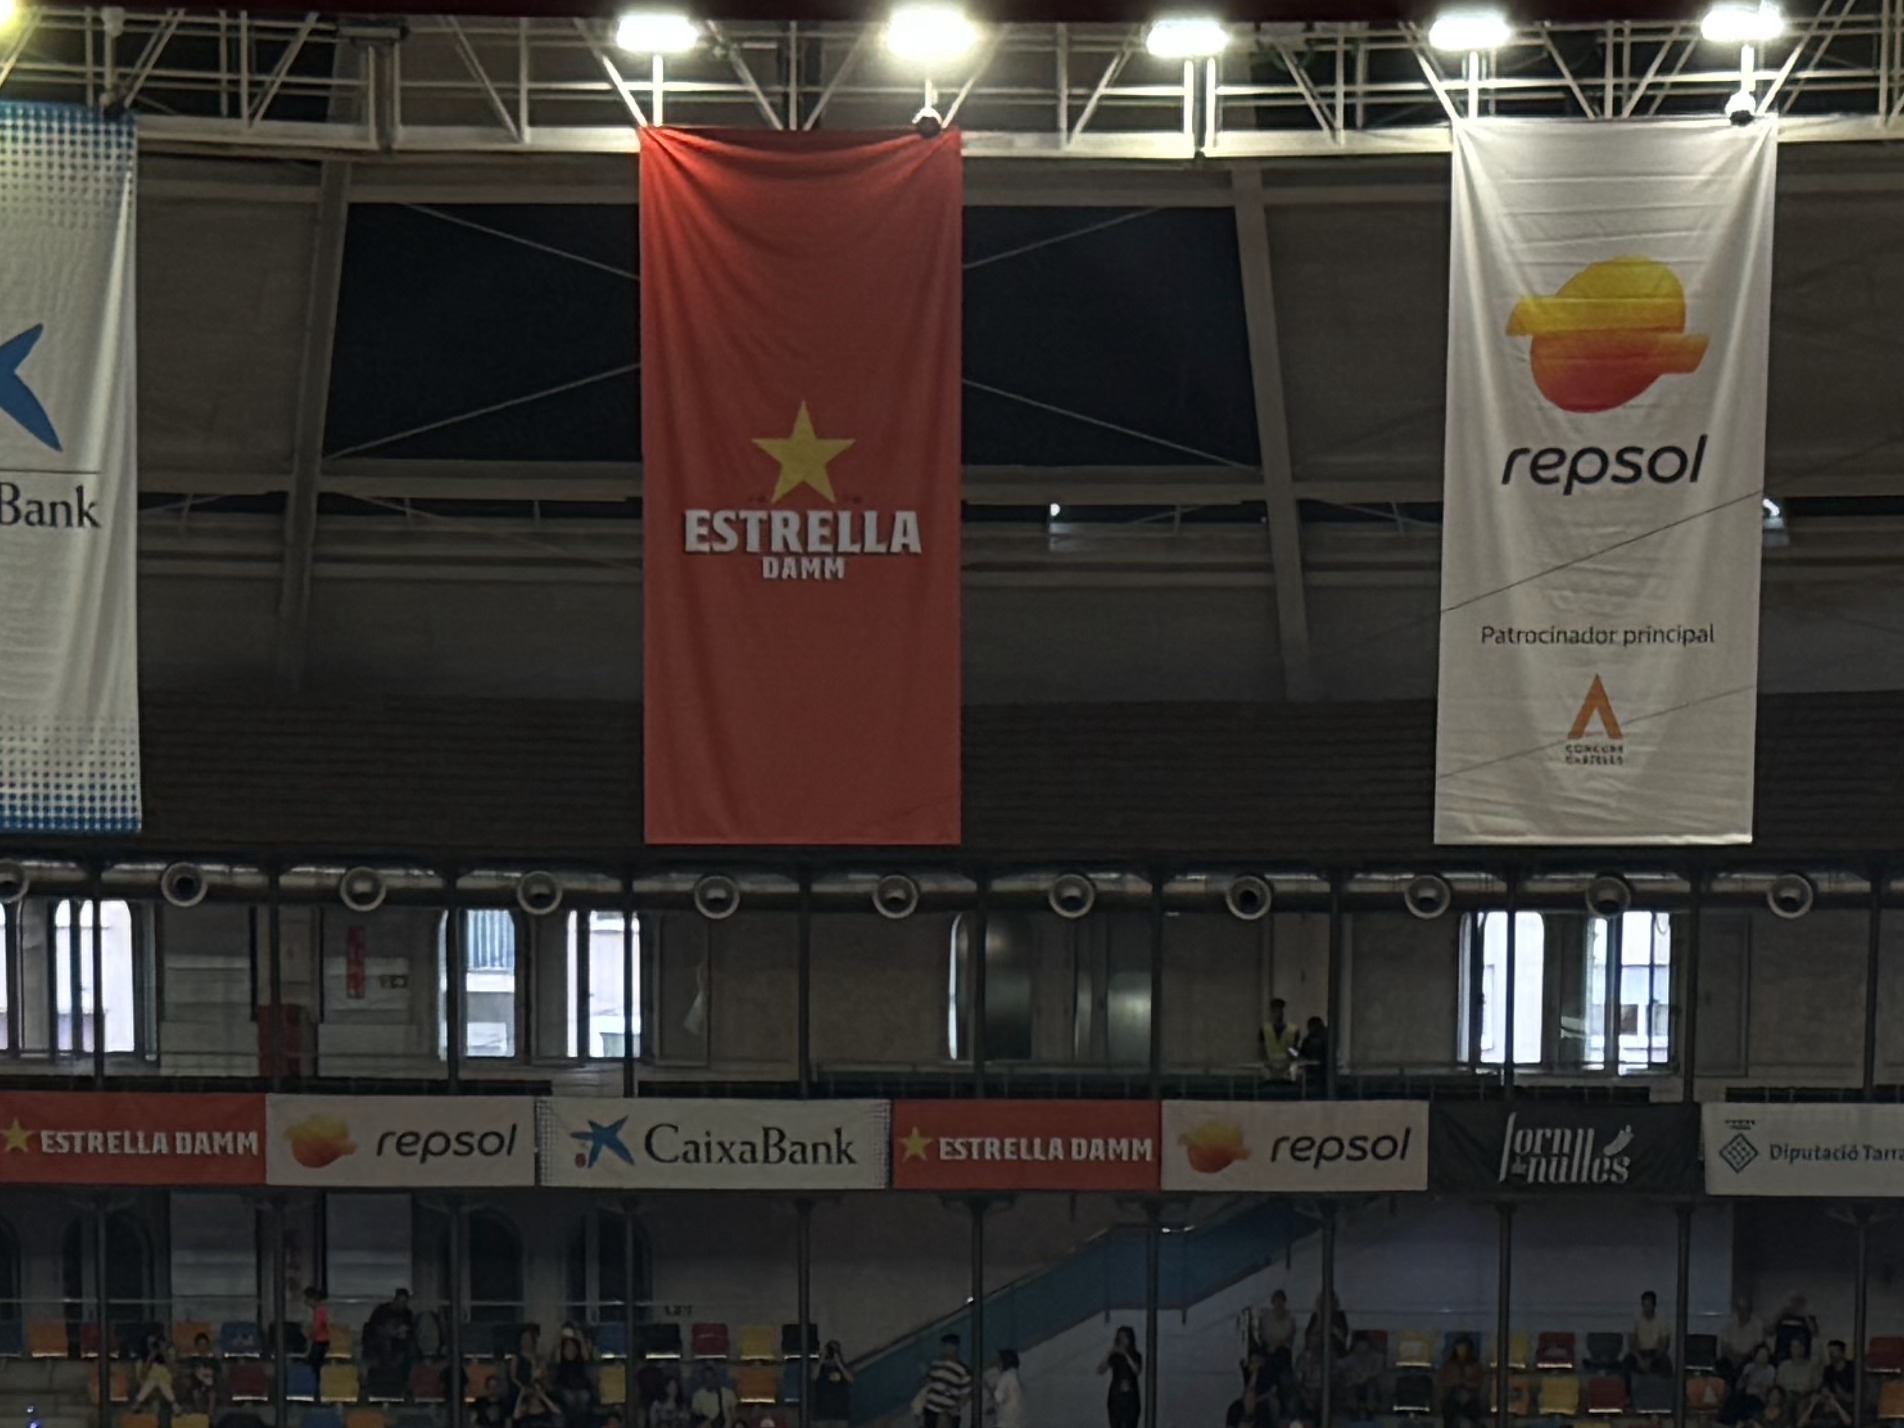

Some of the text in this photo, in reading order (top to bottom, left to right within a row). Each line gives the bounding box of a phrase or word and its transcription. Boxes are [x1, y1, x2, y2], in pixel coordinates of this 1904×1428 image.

[1501, 434, 1708, 495] repsol
[684, 509, 922, 555] ESTRELLA
[762, 555, 846, 580] DAMM
[1480, 623, 1715, 648] Patrocinador principal
[40, 1129, 259, 1155] ESTRELLA DAMM
[376, 1123, 518, 1164] repsol
[644, 1123, 859, 1167] CaixaBank
[939, 1136, 1153, 1162] ESTRELLA DAMM
[1270, 1127, 1412, 1169] repsol
[1769, 1143, 1859, 1165] Diputació
